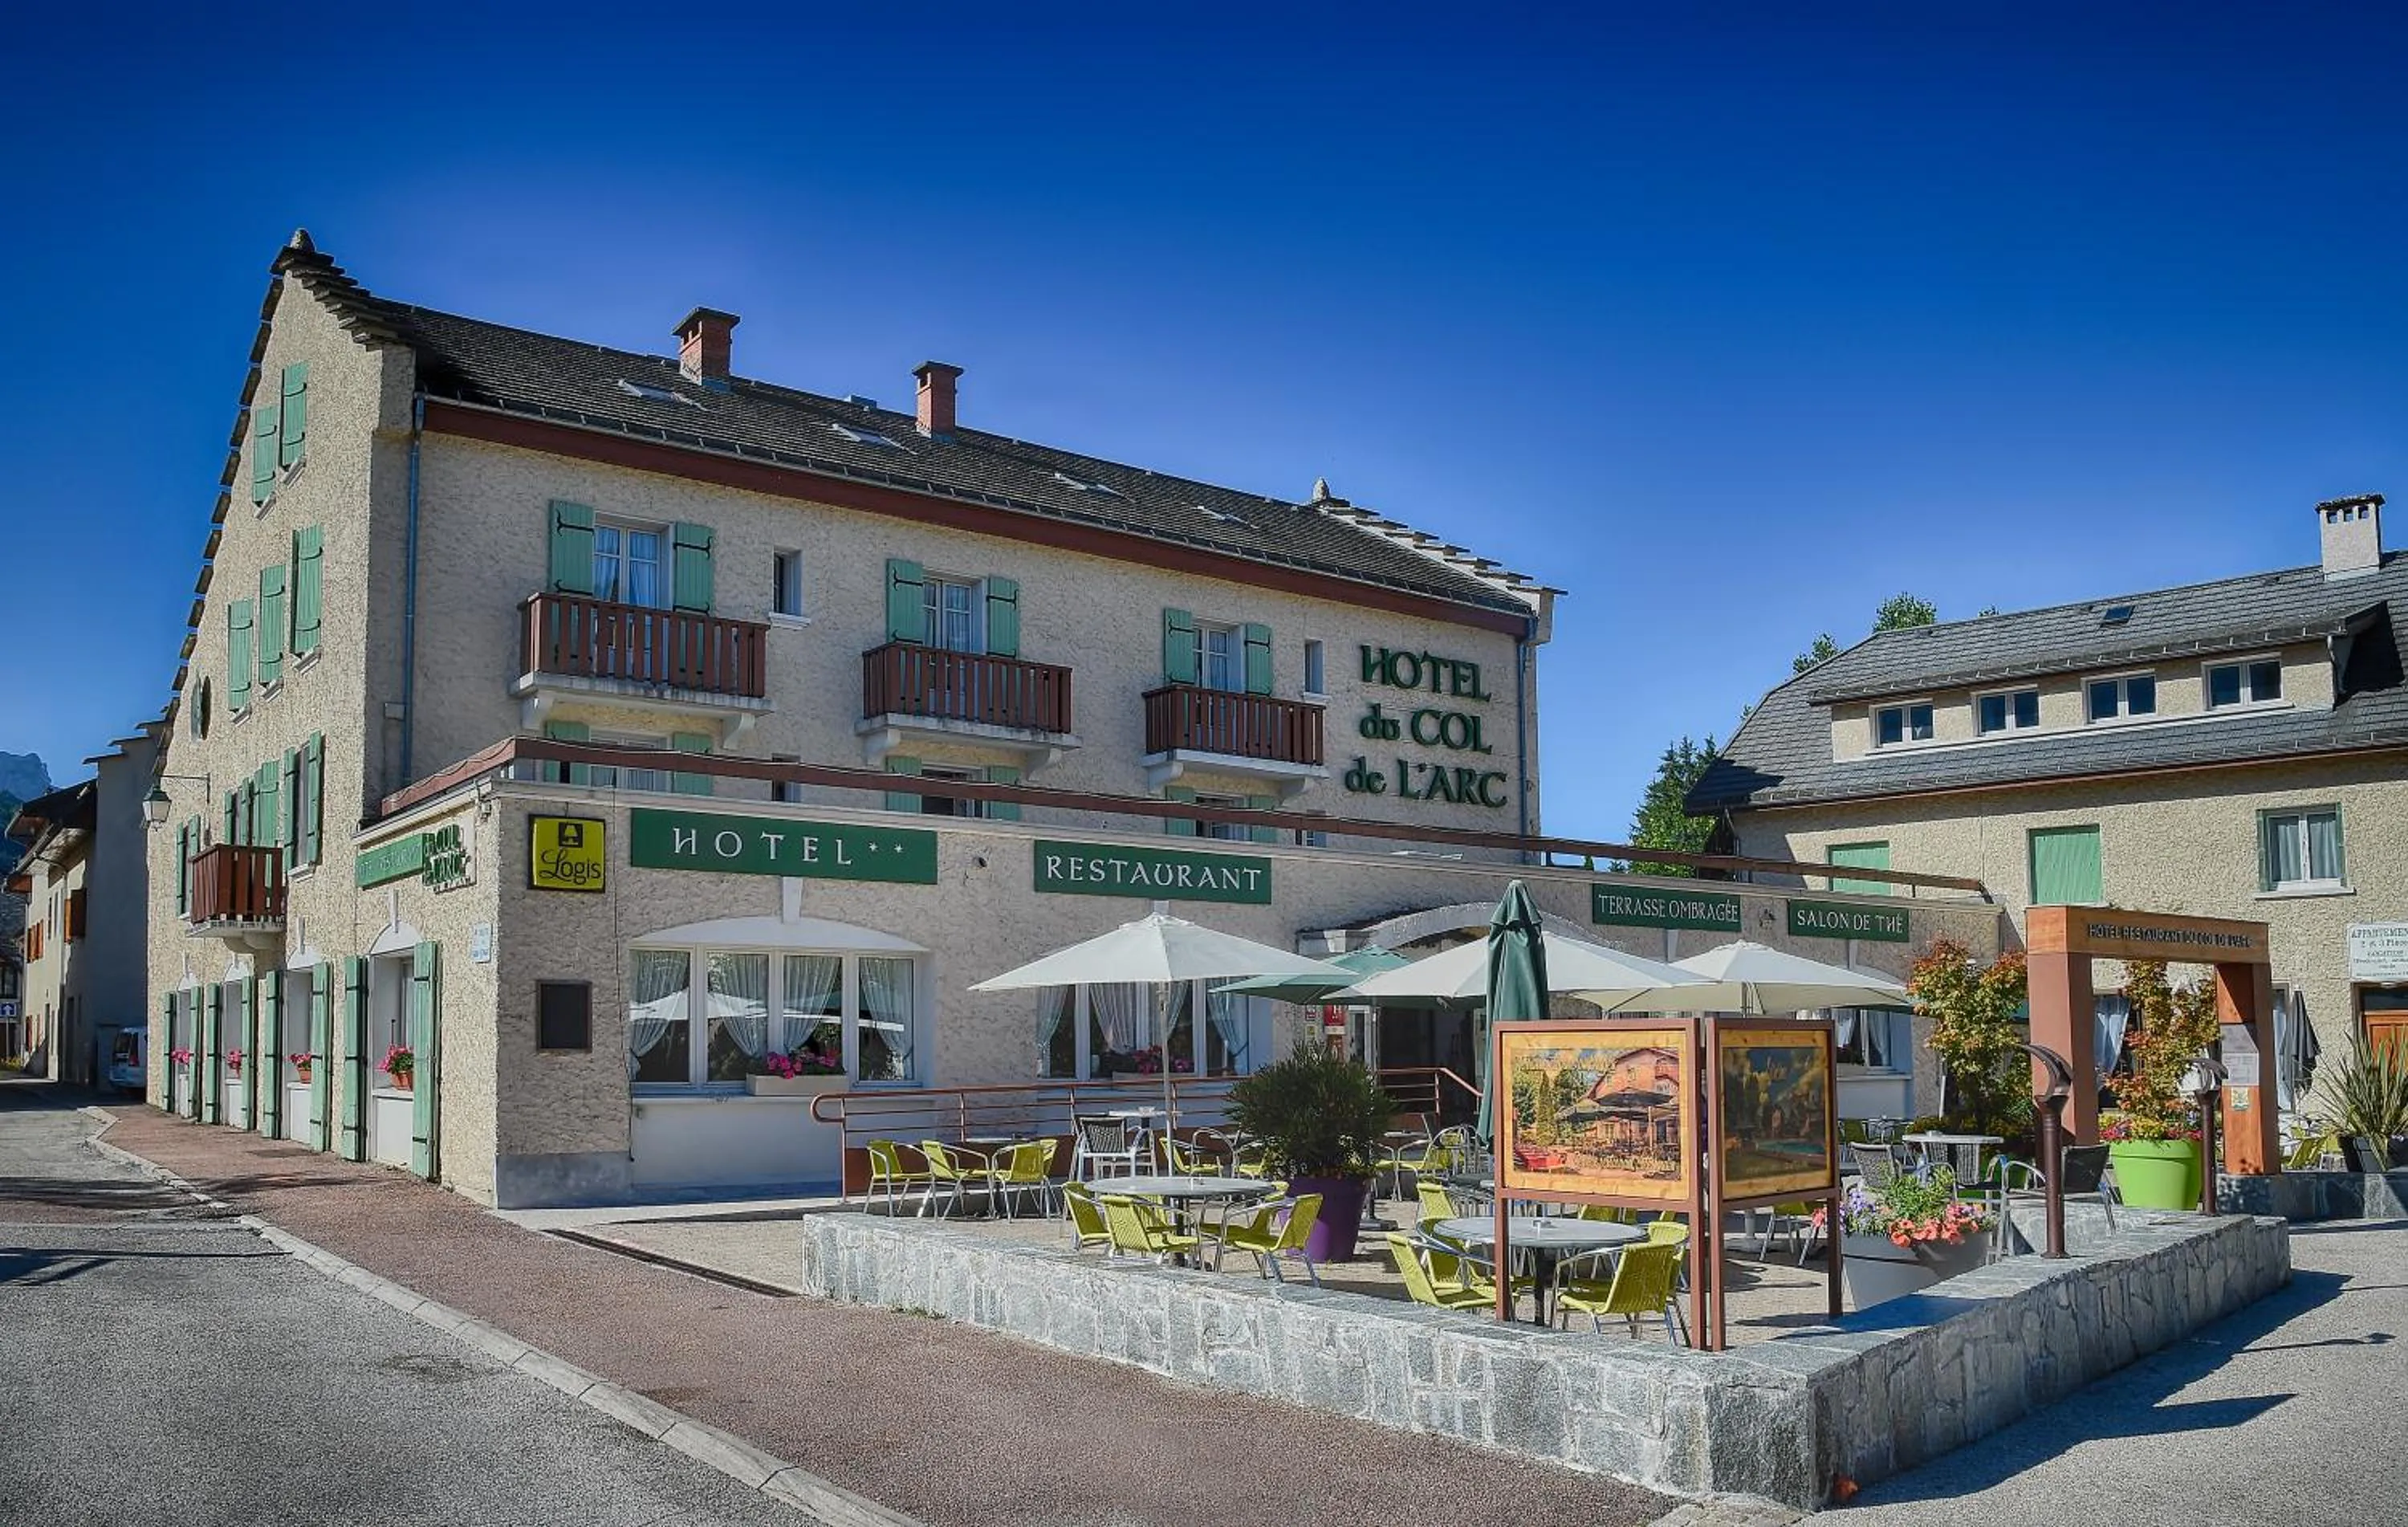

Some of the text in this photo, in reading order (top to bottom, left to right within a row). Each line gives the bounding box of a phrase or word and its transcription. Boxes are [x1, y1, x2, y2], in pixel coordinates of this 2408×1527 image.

[1361, 645, 1492, 702] HOTEL
[1360, 703, 1492, 755] du COL
[1345, 756, 1507, 808] de L'ARC
[673, 828, 852, 865] HOTEL
[539, 848, 602, 884] Logis
[1046, 855, 1262, 891] RESTAURANT
[1598, 894, 1739, 923] TERRASSE OMBRAGÉE
[1797, 910, 1903, 934] SALON DE THÉ
[2089, 924, 2120, 939] HOTEL
[2123, 926, 2183, 943] RESTAURANT
